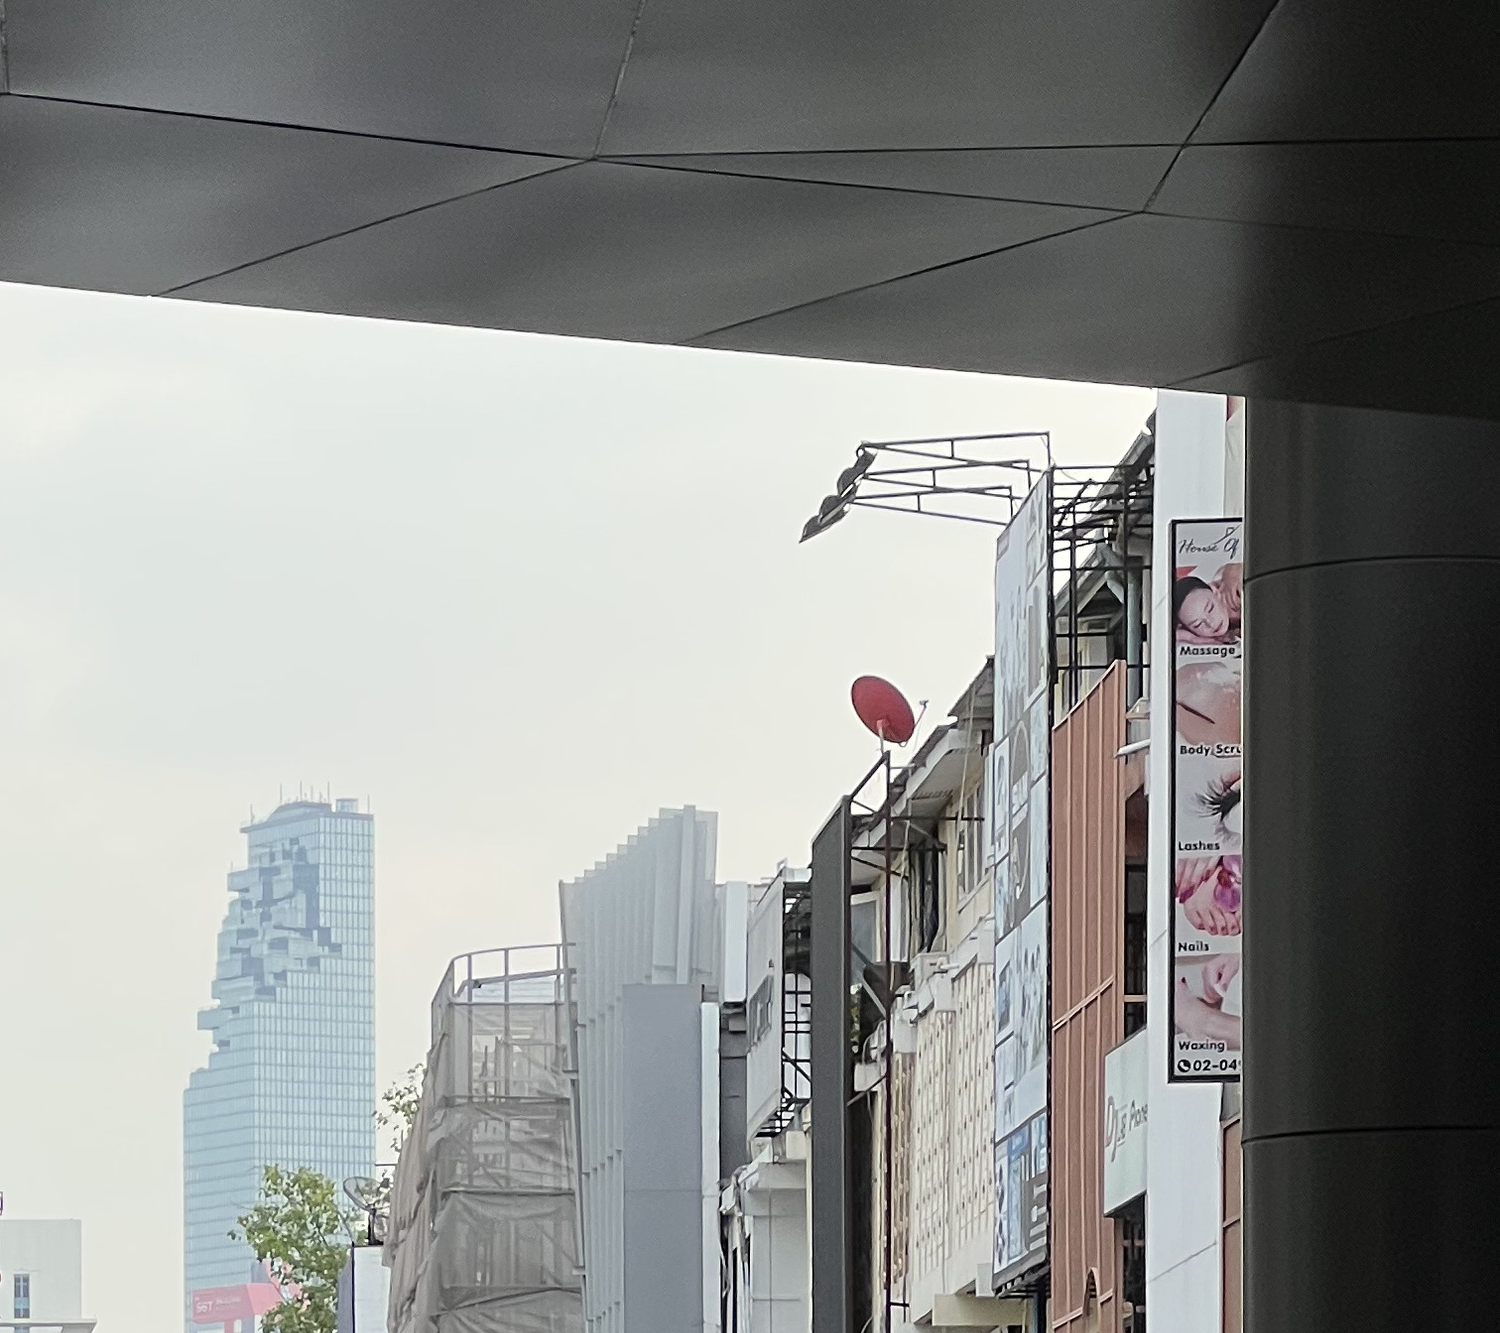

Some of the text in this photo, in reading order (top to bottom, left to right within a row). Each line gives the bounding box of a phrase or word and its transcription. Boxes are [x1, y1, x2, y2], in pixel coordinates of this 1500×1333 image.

[1179, 645, 1236, 658] Massage
[1179, 745, 1212, 757] Body
[1178, 840, 1220, 851] Lashes
[1177, 940, 1210, 953] Nails
[1178, 1039, 1225, 1053] Waxing
[1192, 1058, 1241, 1072] 02-04
